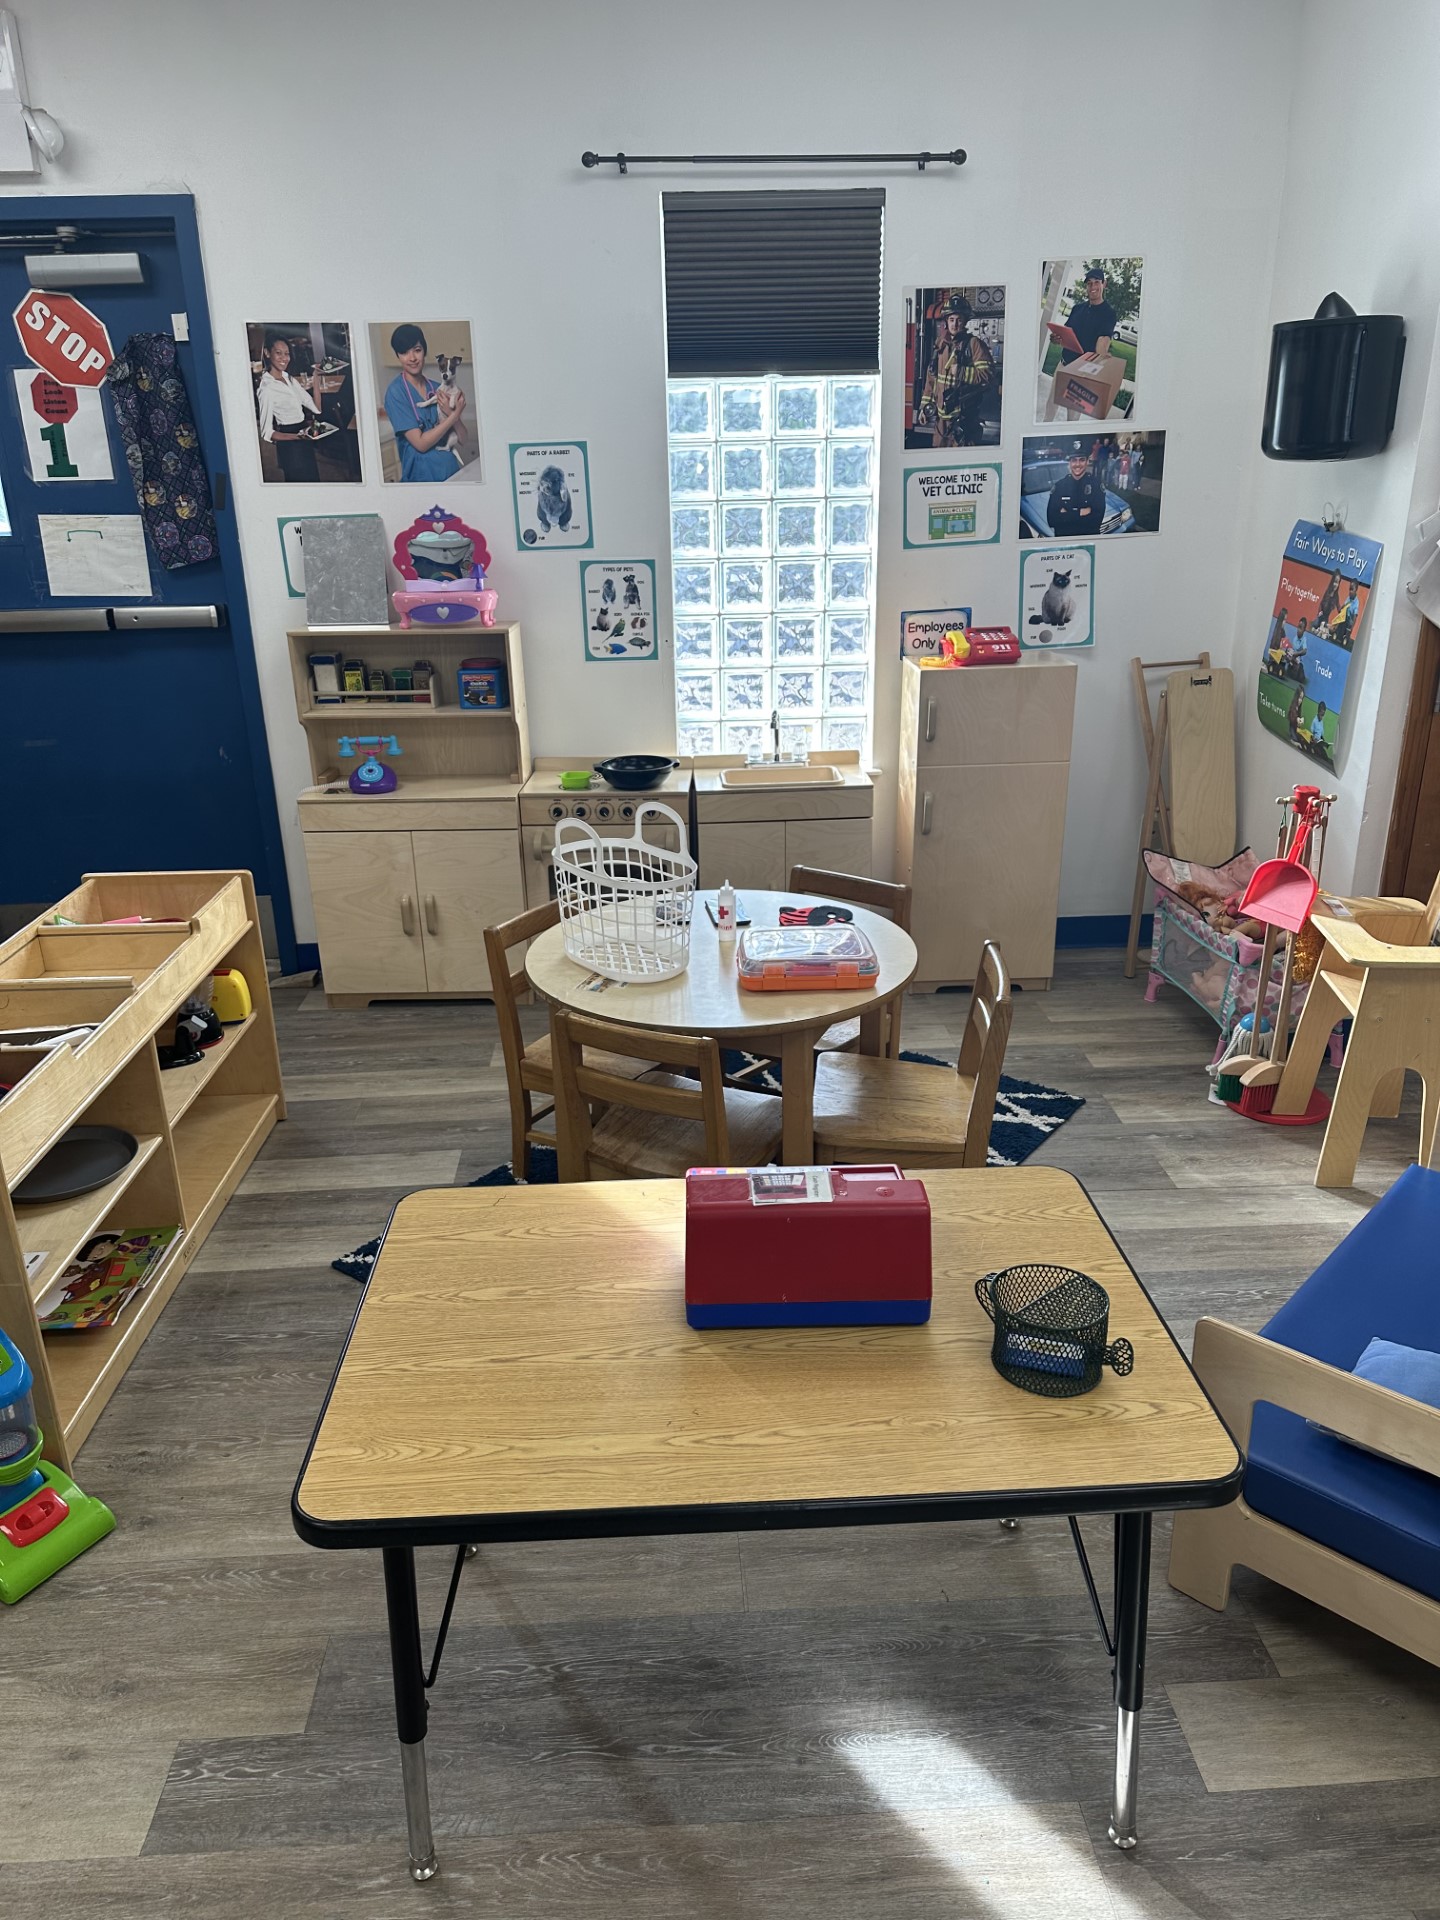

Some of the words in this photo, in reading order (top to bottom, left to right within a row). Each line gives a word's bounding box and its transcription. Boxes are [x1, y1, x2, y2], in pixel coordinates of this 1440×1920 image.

[25, 301, 106, 373] STOP
[918, 475, 958, 485] WELCOME
[960, 474, 971, 483] TO
[973, 472, 988, 481] THE
[922, 486, 941, 497] VET
[945, 483, 983, 496] CLINIC
[1293, 531, 1310, 550] Fair
[1312, 536, 1335, 564] Ways
[1336, 548, 1345, 563] to
[1346, 547, 1368, 576] Play
[1281, 577, 1295, 598] Play
[1295, 585, 1320, 603] together
[907, 621, 965, 634] Employees
[911, 637, 936, 650] Only
[991, 643, 1012, 651] 911
[1315, 659, 1333, 680] Trade
[1259, 691, 1271, 709] Take
[1271, 703, 1286, 718] turns
